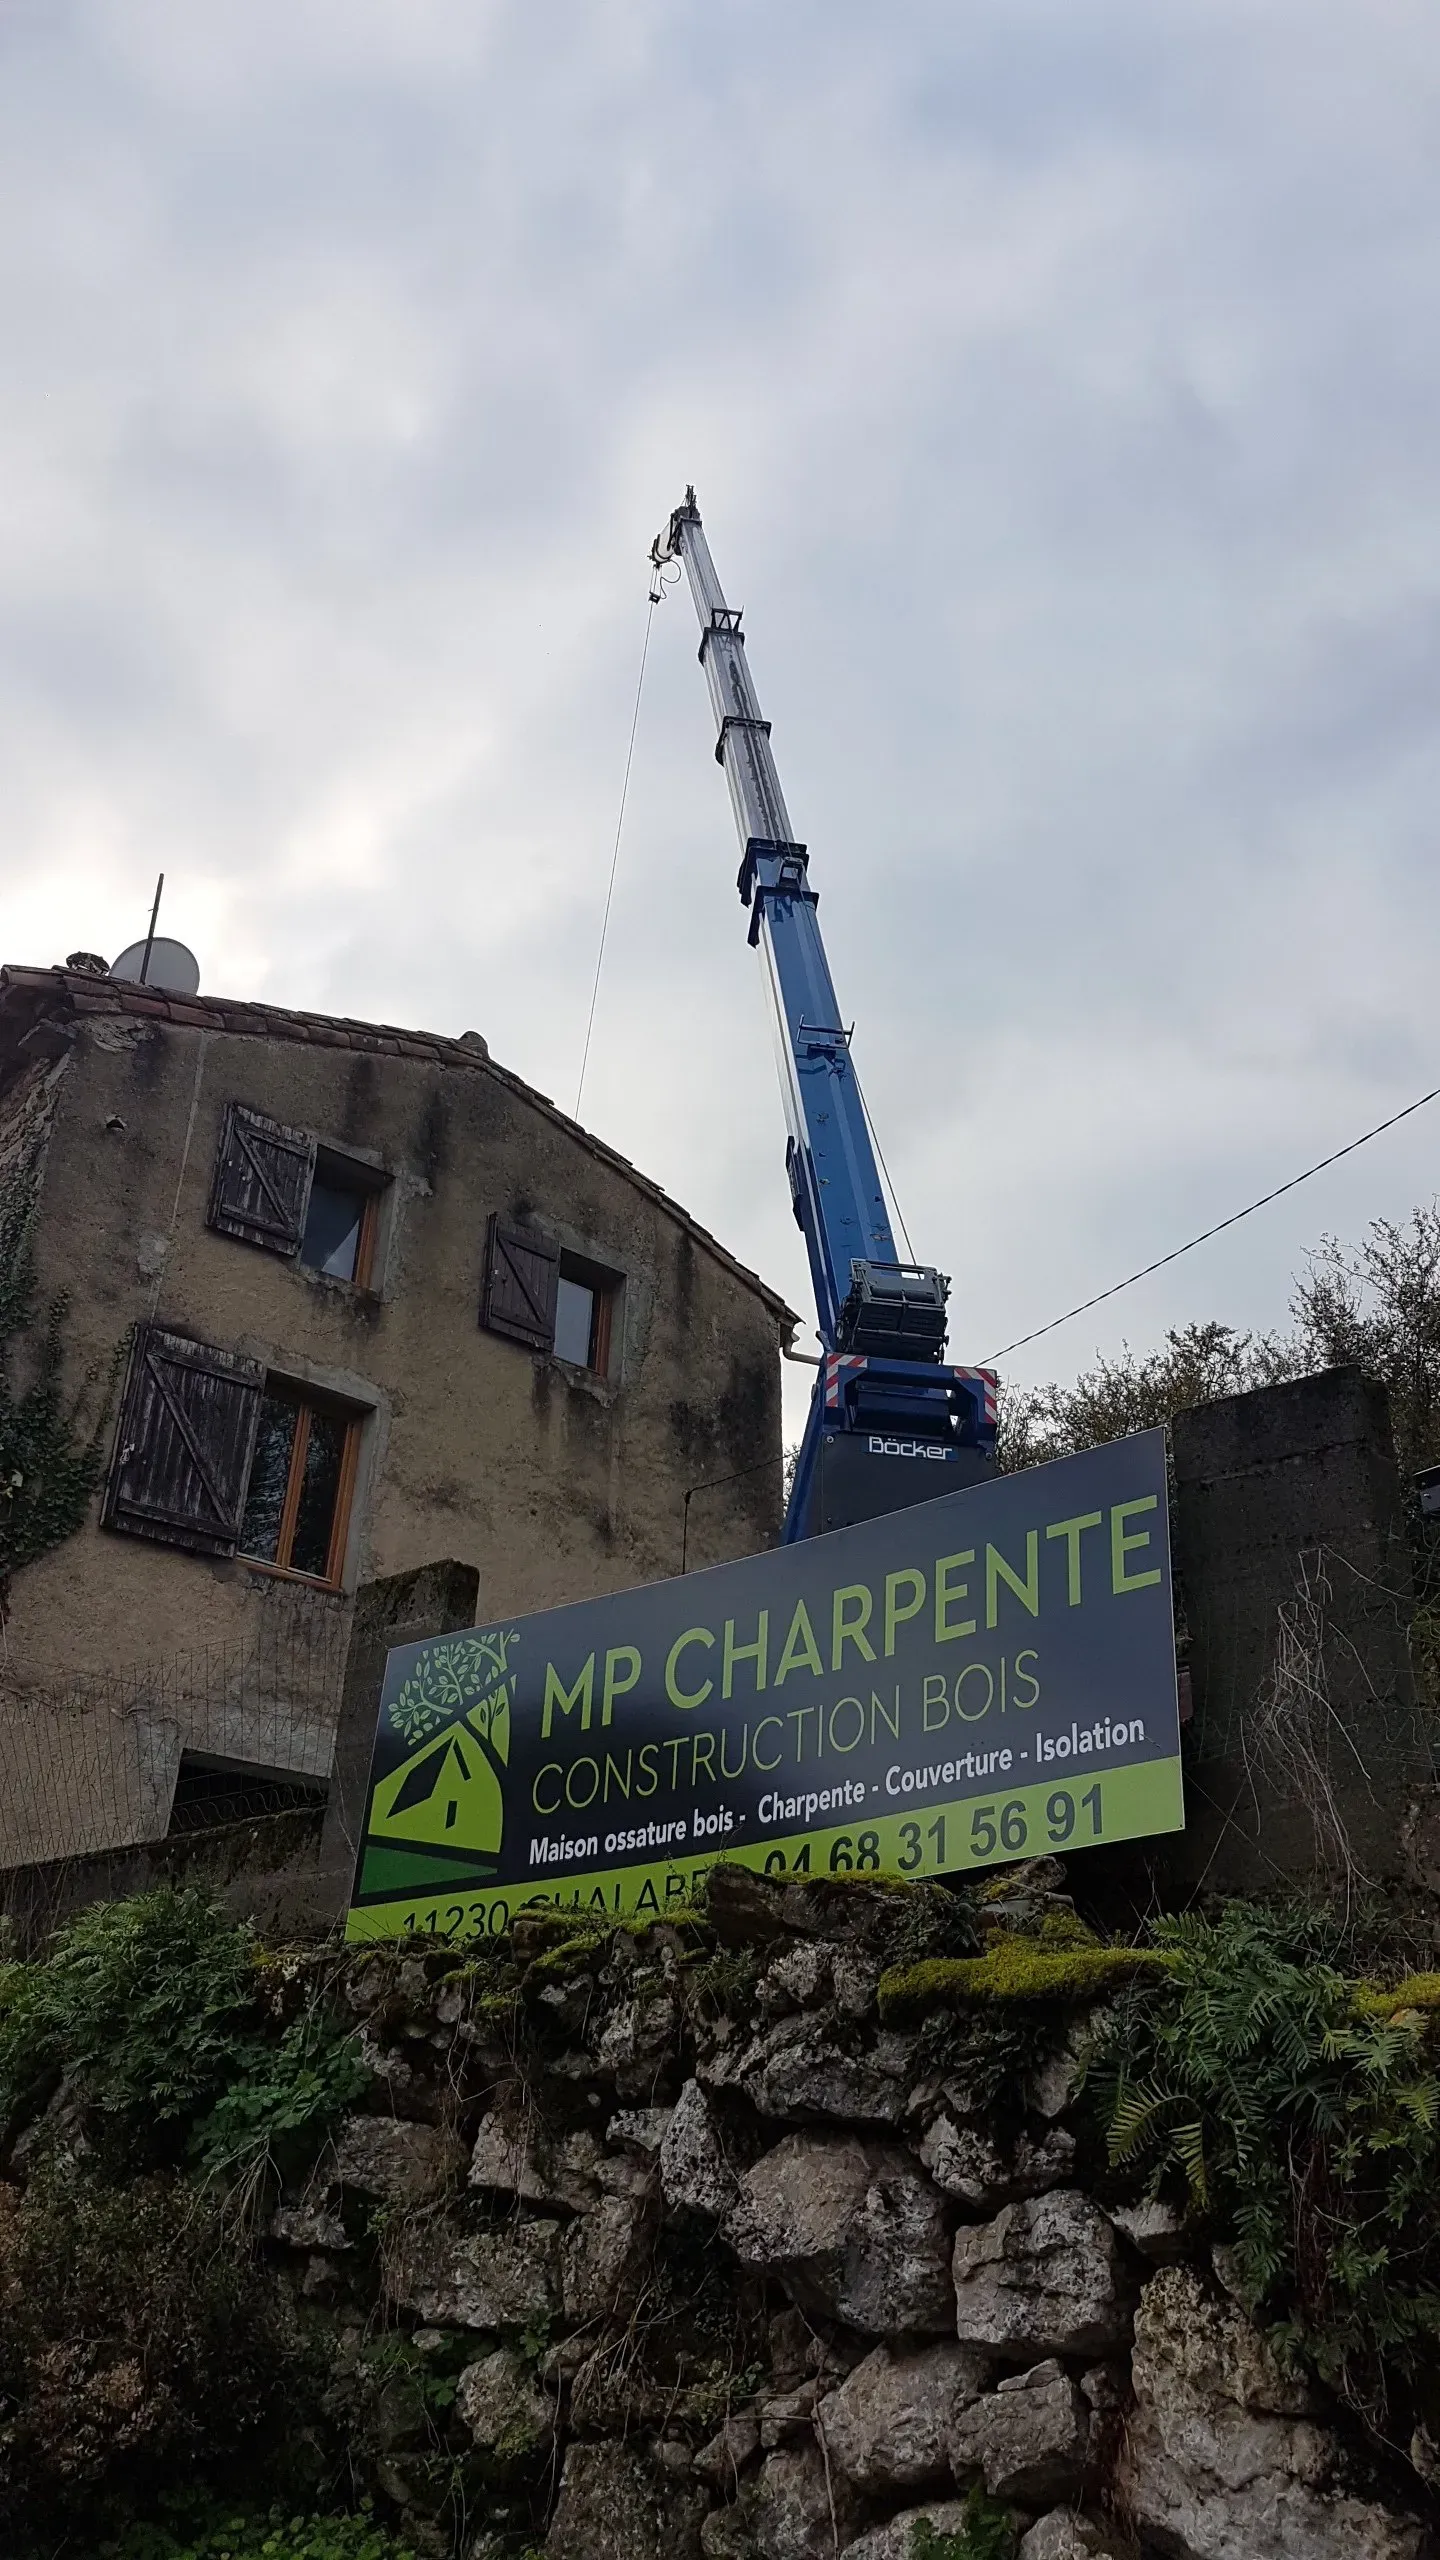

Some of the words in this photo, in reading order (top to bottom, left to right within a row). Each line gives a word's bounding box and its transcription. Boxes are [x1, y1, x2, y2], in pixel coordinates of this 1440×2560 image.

[868, 1436, 953, 1460] Böcker
[541, 1644, 642, 1739] MP
[664, 1494, 1162, 1710] CHARPENTE
[529, 1832, 599, 1865] Maison
[604, 1818, 687, 1853] ossature
[693, 1804, 734, 1838] bois
[758, 1780, 865, 1824] Charpente
[885, 1748, 1013, 1796] Couverture
[1036, 1716, 1145, 1763] Isolation
[532, 1684, 900, 1814] CONSTRUCTION
[923, 1648, 1040, 1732] BOIS
[829, 1831, 881, 1872] 68
[897, 1815, 946, 1871] 31
[969, 1800, 1027, 1857] 56
[1046, 1783, 1103, 1842] 91
